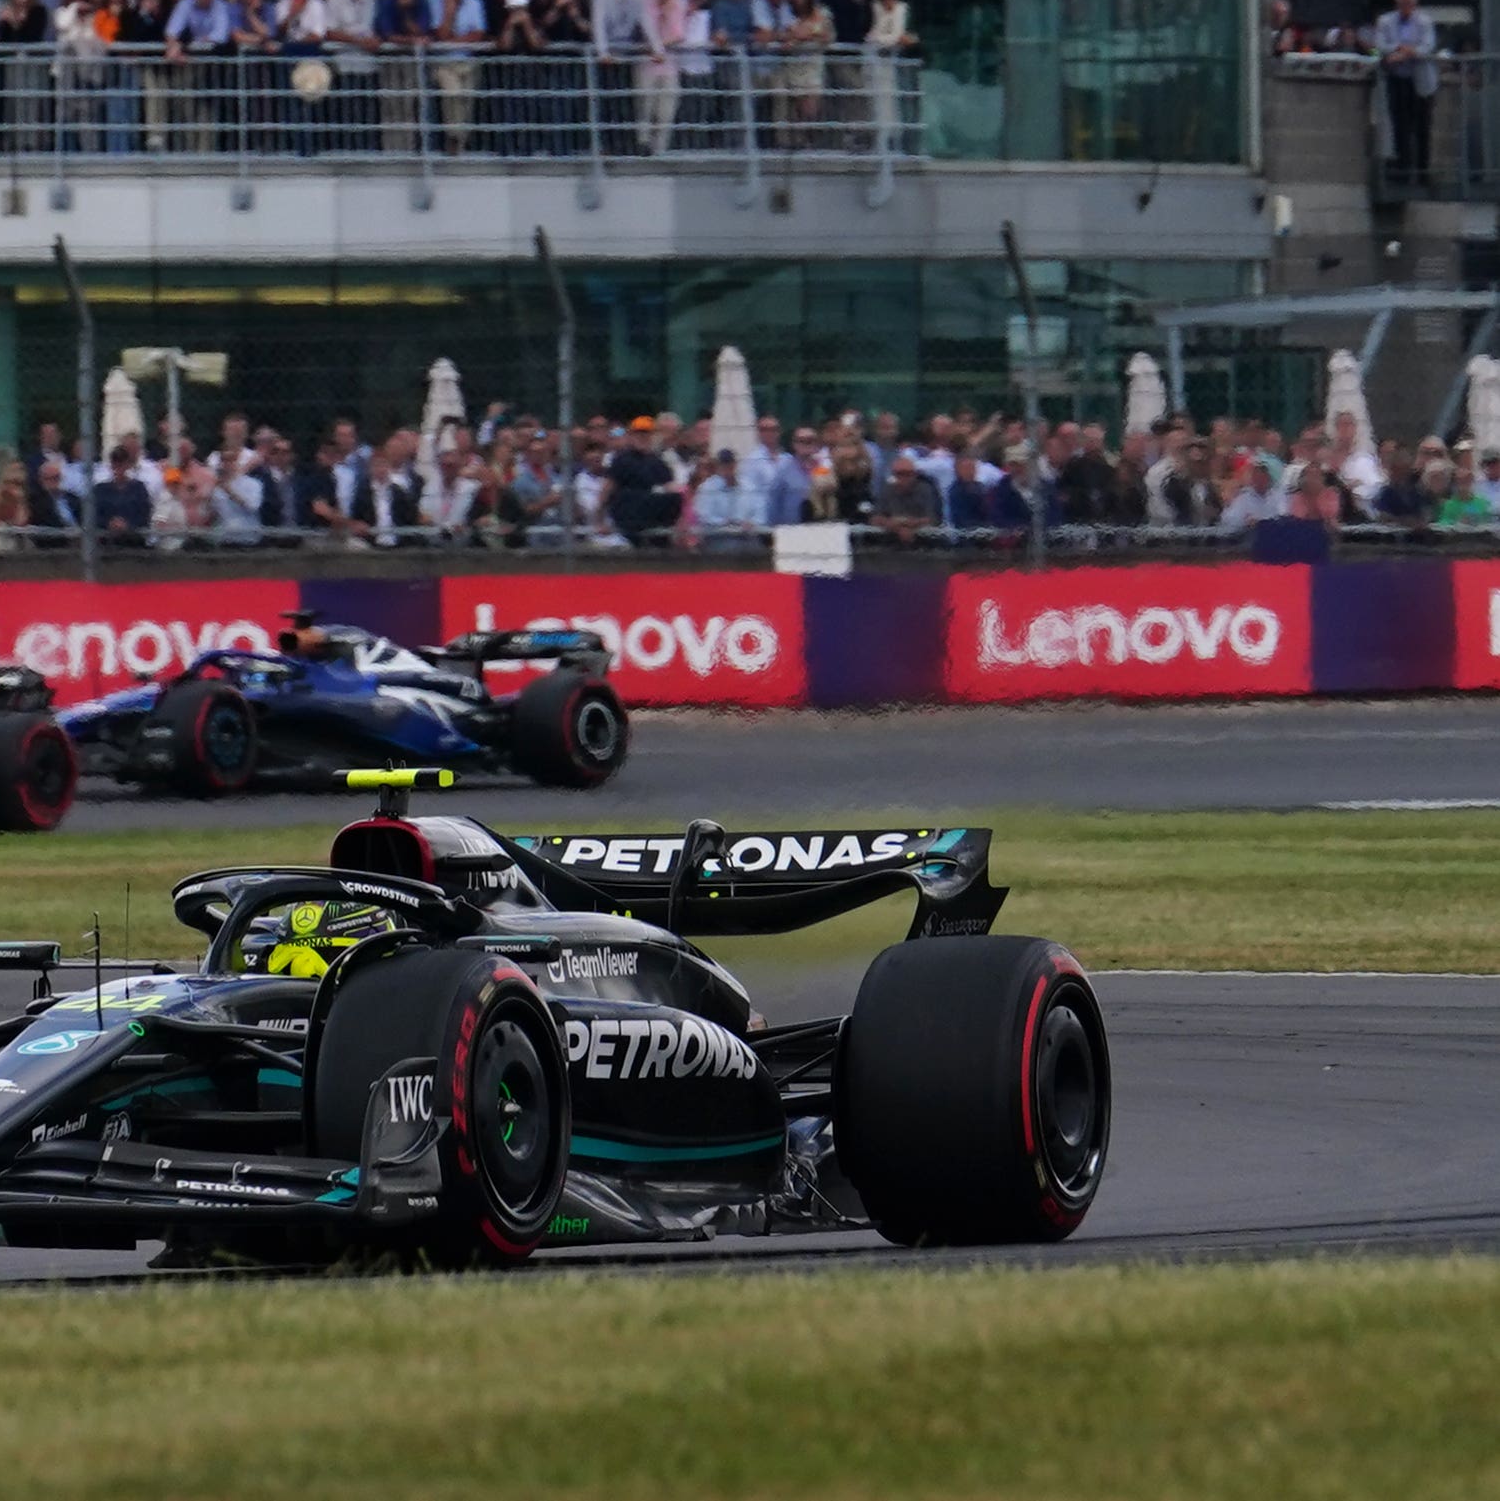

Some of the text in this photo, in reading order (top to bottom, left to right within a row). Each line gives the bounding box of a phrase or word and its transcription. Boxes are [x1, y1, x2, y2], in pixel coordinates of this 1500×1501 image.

[977, 599, 1280, 668] Lenovo
[348, 881, 421, 909] CROWDSTRIKE
[484, 943, 532, 953] PETRONAS
[562, 946, 639, 980] TeamViewer
[562, 1018, 758, 1081] PETRONAS
[387, 1074, 435, 1123] IWC
[175, 1179, 292, 1197] PETRONAS
